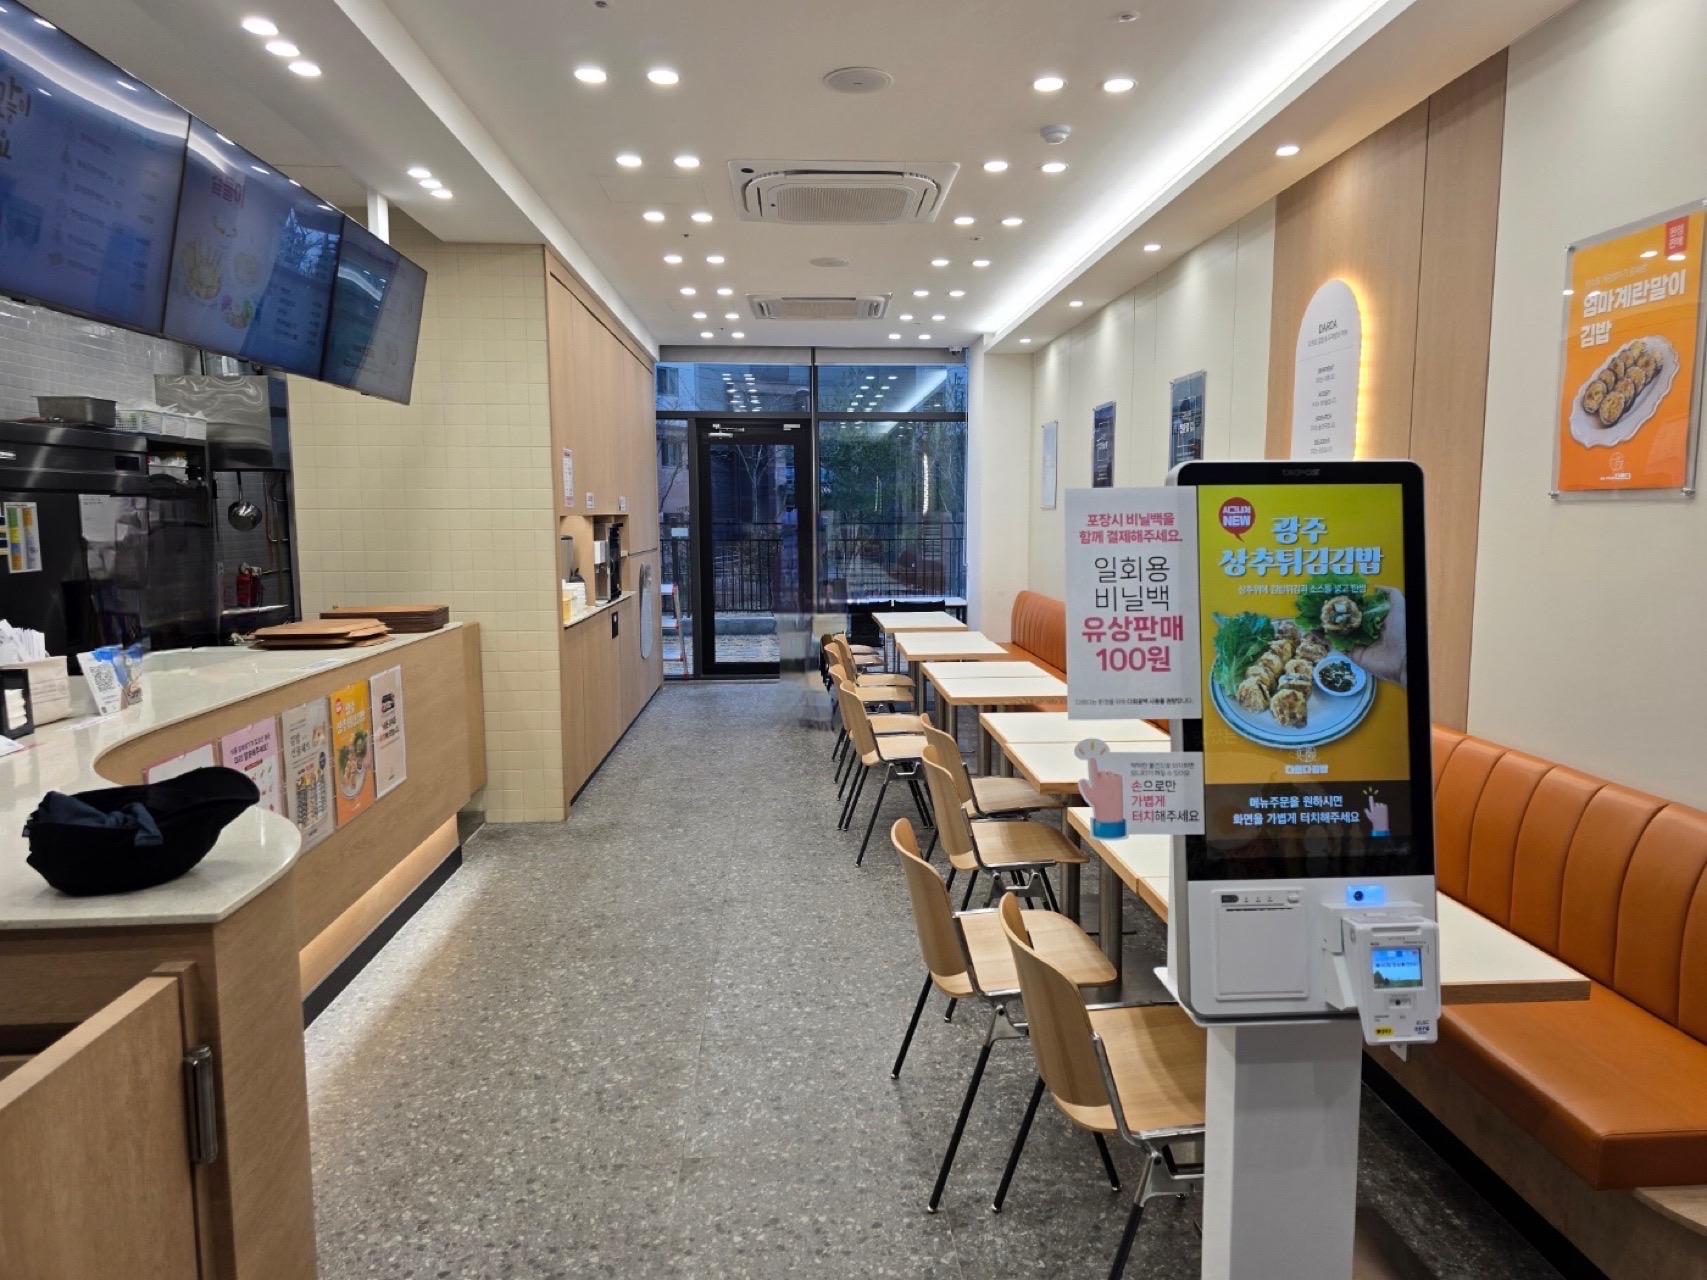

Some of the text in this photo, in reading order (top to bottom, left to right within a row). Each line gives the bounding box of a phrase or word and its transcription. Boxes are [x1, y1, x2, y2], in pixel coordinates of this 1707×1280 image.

[1583, 269, 1687, 318] 엄마계란말이
[1580, 320, 1612, 348] 김밥
[1087, 512, 1175, 527] 포장시 비닐백을
[1223, 515, 1251, 527] NEW
[1079, 529, 1183, 544] 함께 결제해주세요.
[1271, 516, 1328, 545] 광주
[1094, 556, 1170, 583] 일회용
[1218, 547, 1384, 577] 상추튀김김밥
[1095, 585, 1170, 612] 비닐백
[1082, 615, 1184, 643] 유상판매
[1095, 646, 1172, 672] 100원
[1131, 780, 1177, 793] 손으로만
[1131, 795, 1165, 808] 가볍게
[1249, 795, 1343, 808] 메뉴주문을 원하시면
[1132, 810, 1200, 823] 터치해주세요
[1233, 811, 1360, 826] 화면을 가볍게 터치해주세요
